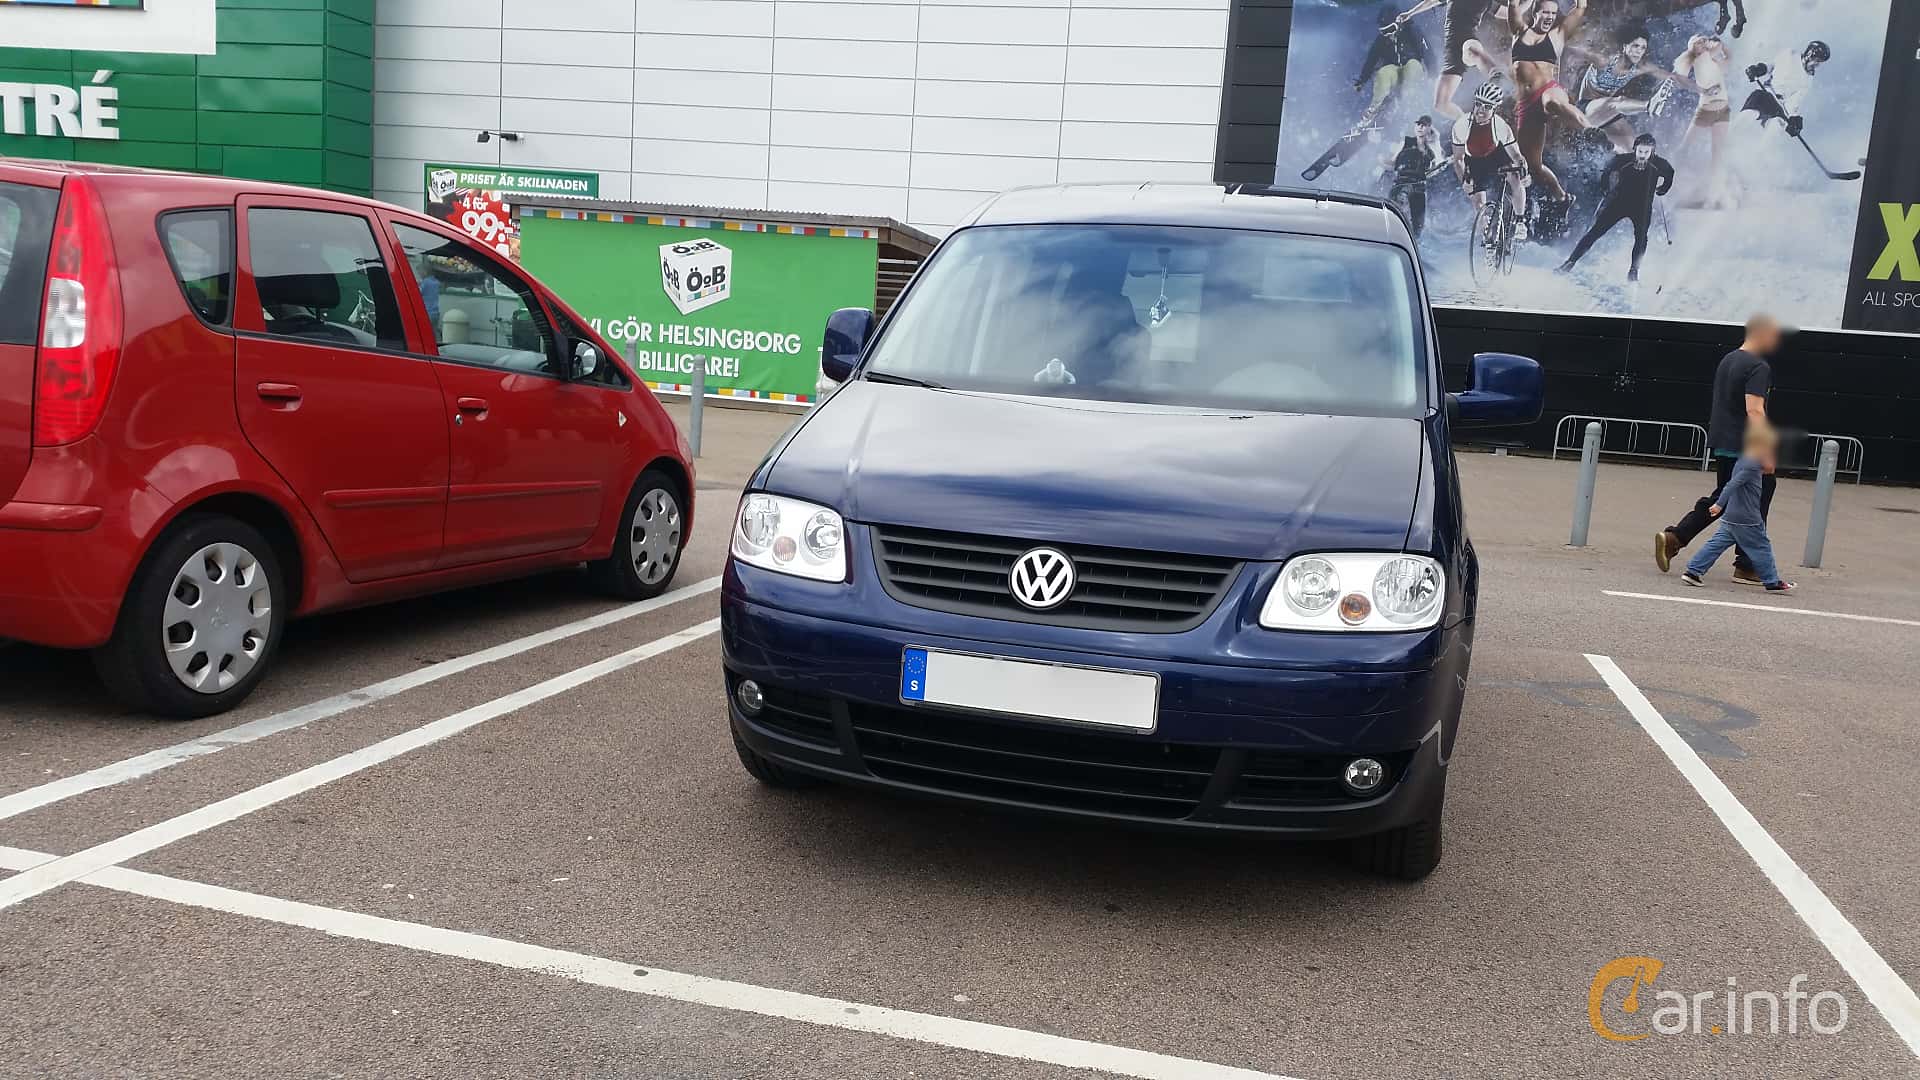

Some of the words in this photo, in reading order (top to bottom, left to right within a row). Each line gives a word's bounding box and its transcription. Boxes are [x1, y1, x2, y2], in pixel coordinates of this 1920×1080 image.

[0, 69, 120, 140] TRÉ
[460, 173, 496, 185] PRISET
[498, 172, 514, 187] ÄR
[517, 176, 588, 191] SKILLNADEN
[462, 195, 471, 209] 4
[1862, 291, 1888, 306] ALL
[607, 315, 653, 342] GÖR
[658, 323, 802, 354] HELSINGBORG
[910, 680, 919, 691] S
